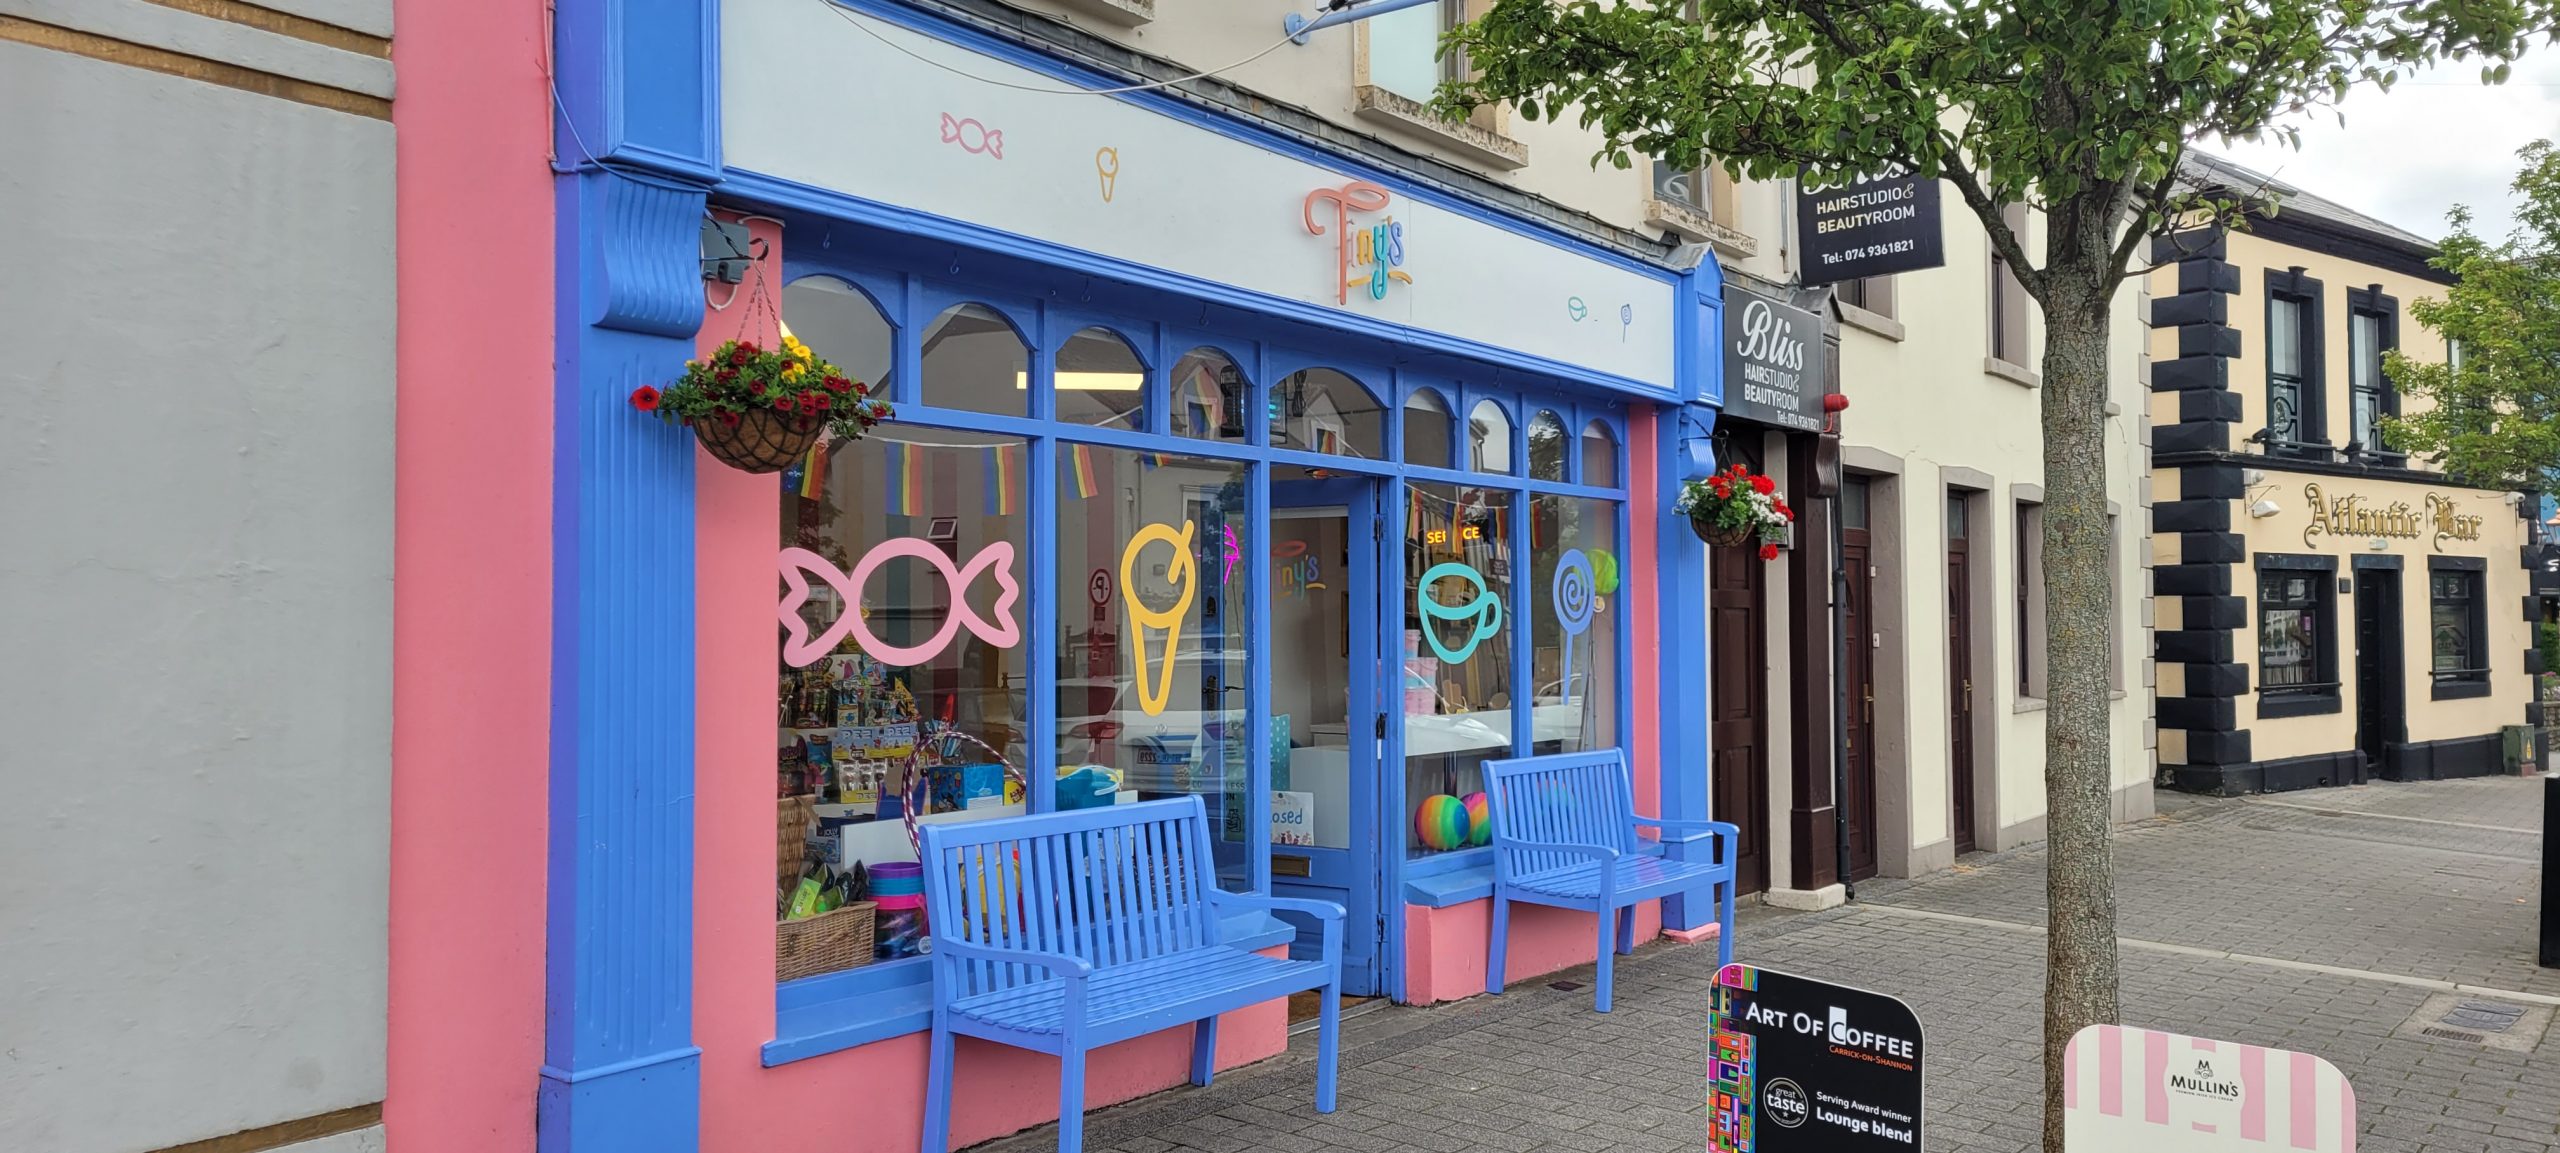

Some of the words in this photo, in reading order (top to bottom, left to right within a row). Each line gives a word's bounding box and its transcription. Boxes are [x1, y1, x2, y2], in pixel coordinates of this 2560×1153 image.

[1817, 204, 1916, 234] BEAUTYROOM
[1304, 181, 1405, 305] Tiny's
[1821, 252, 1843, 265] Tel:
[1845, 248, 1866, 262] 074
[1867, 239, 1914, 259] 9361821
[1737, 300, 1804, 371] Bliss
[1744, 384, 1800, 412] BEAUTYROOM
[2304, 482, 2423, 549] Atlantic
[2425, 491, 2483, 552] Bar
[1426, 526, 1481, 544] SECE
[1270, 807, 1303, 825] osed
[1745, 1001, 1788, 1029] ART
[1793, 1012, 1824, 1036] OF
[1828, 1005, 1914, 1059] COFFEE
[2198, 1059, 2210, 1070] M
[1775, 1087, 1797, 1099] great
[2170, 1074, 2239, 1097] MULLIN'S
[1767, 1093, 1806, 1115] taste
[1816, 1091, 1850, 1109] Serving
[1851, 1100, 1880, 1116] Award
[1881, 1109, 1912, 1124] winner
[1816, 1106, 1869, 1132] Lounge
[1872, 1120, 1913, 1144] blend
